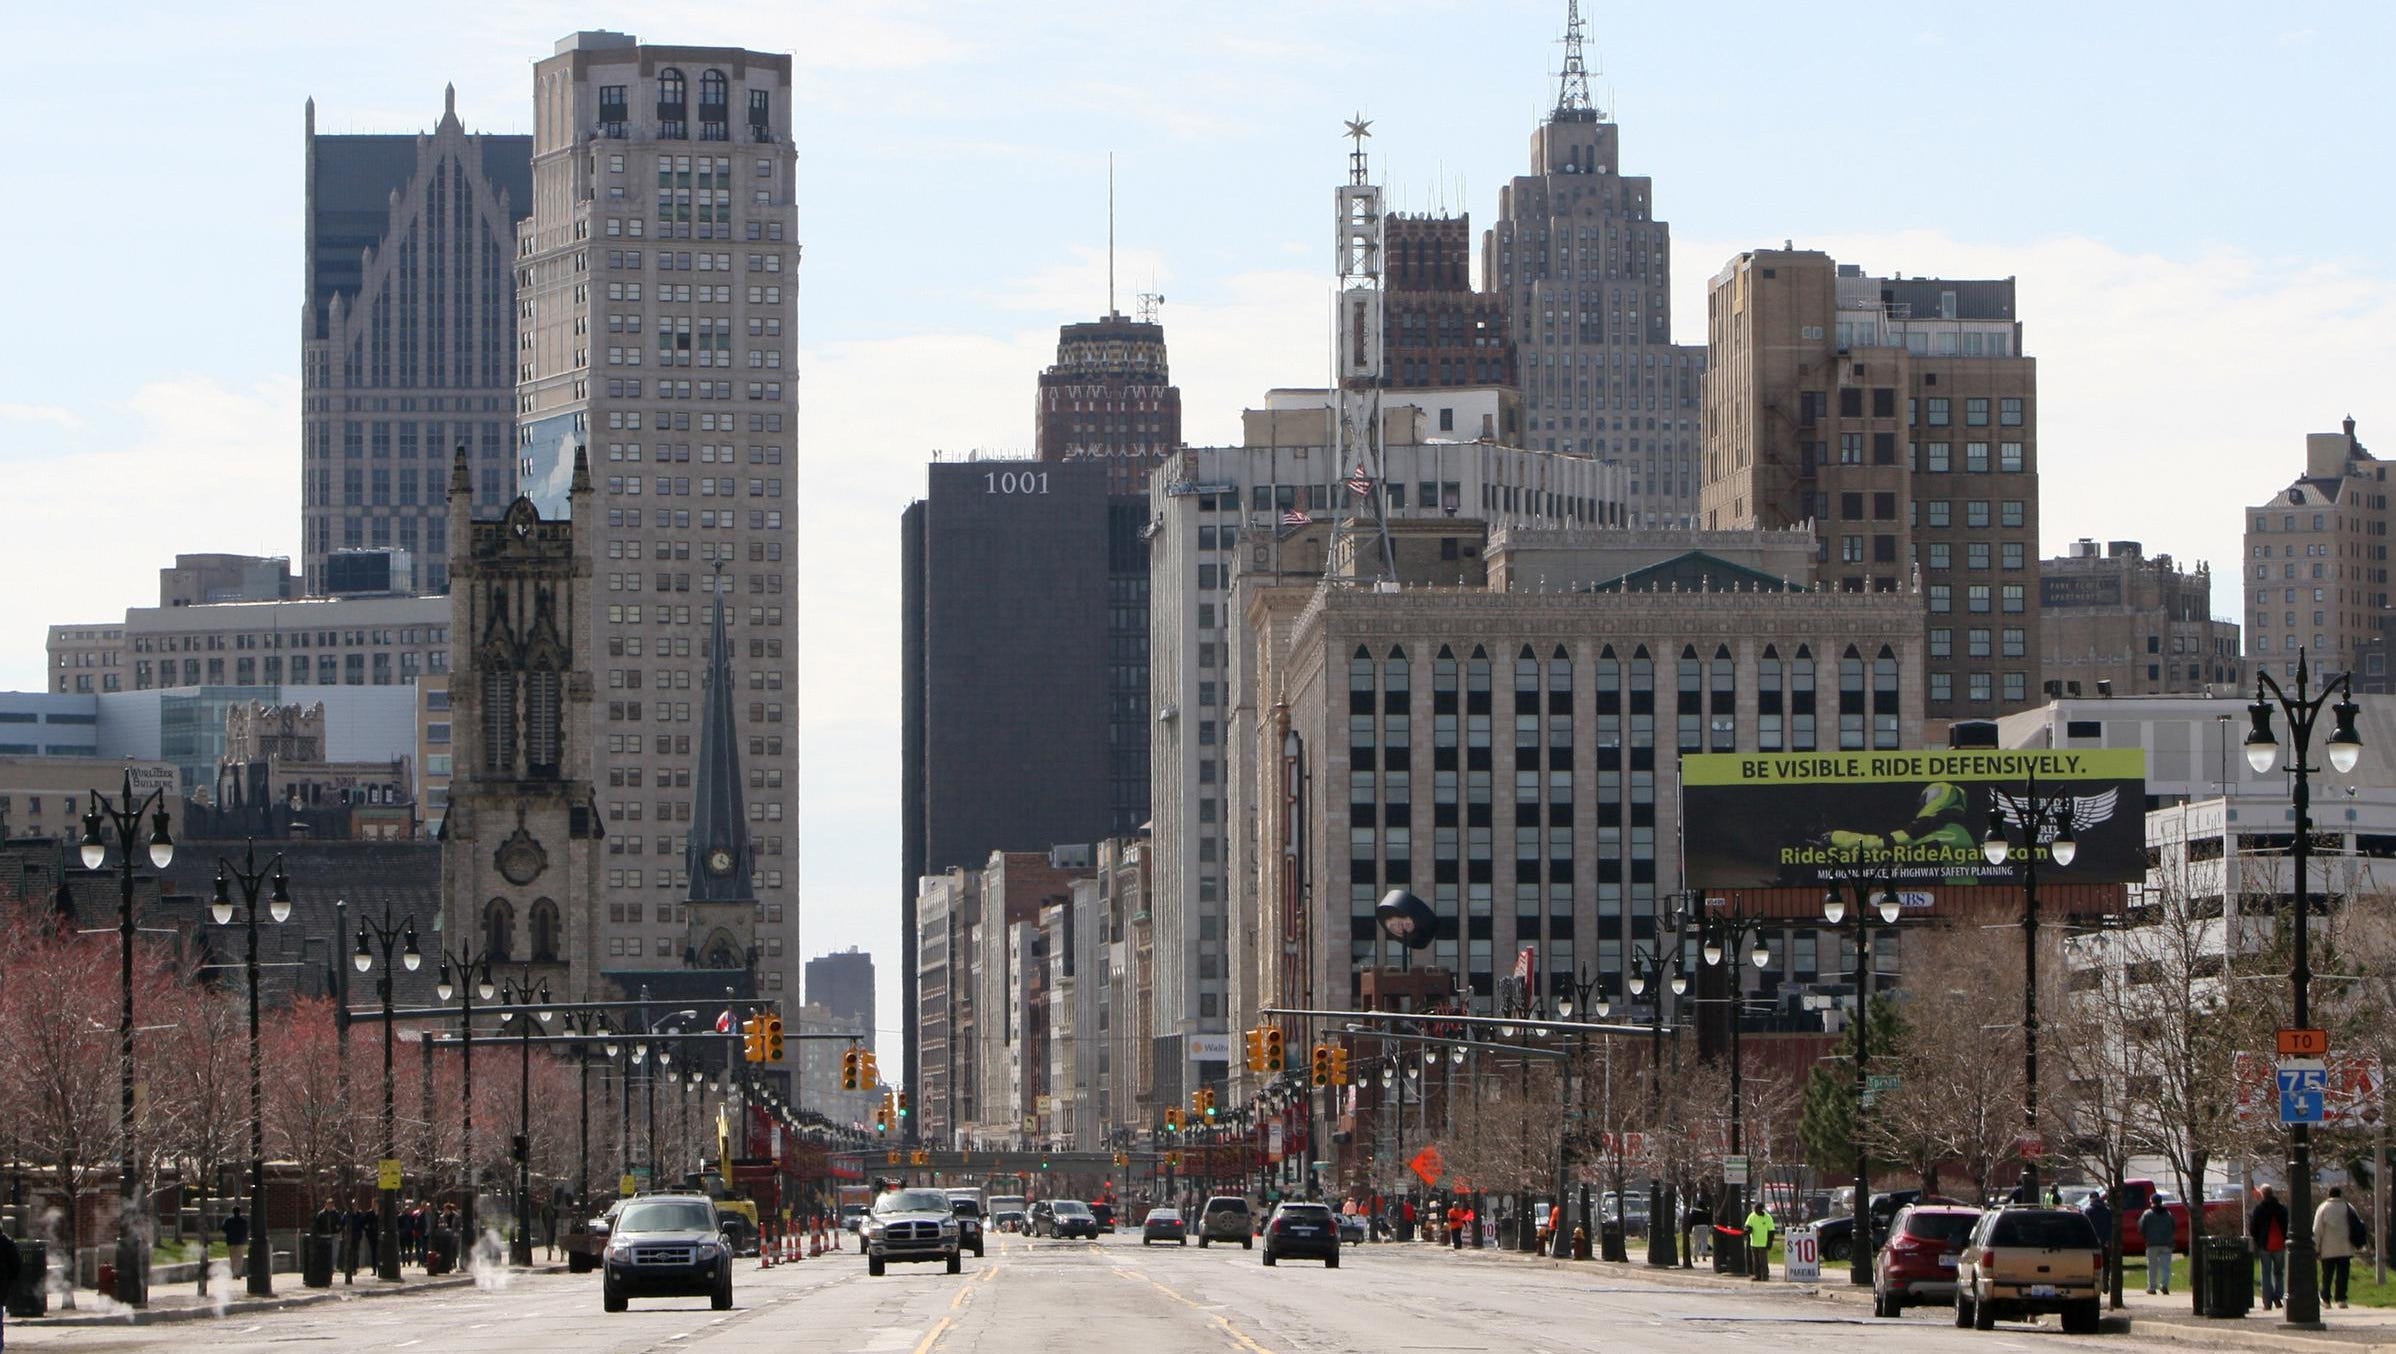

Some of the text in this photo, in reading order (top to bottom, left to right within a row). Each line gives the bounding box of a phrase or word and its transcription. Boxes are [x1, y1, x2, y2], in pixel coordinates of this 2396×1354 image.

[984, 471, 1050, 494] 1001
[1742, 755, 2087, 779] BE VISIBLE. RIDE DEFENSIVELY.
[132, 778, 174, 792] BUILDING
[1781, 844, 2048, 864] RideSafetoRideAgaicom
[1900, 867, 1940, 878] HIGHWAY
[1940, 866, 1970, 877] SAFETY
[1971, 865, 2013, 876] PLANNING
[2291, 1035, 2312, 1049] TO
[2281, 1071, 2322, 1101] 75
[924, 1081, 933, 1132] PARK
[1790, 1268, 1816, 1277] PARKING
